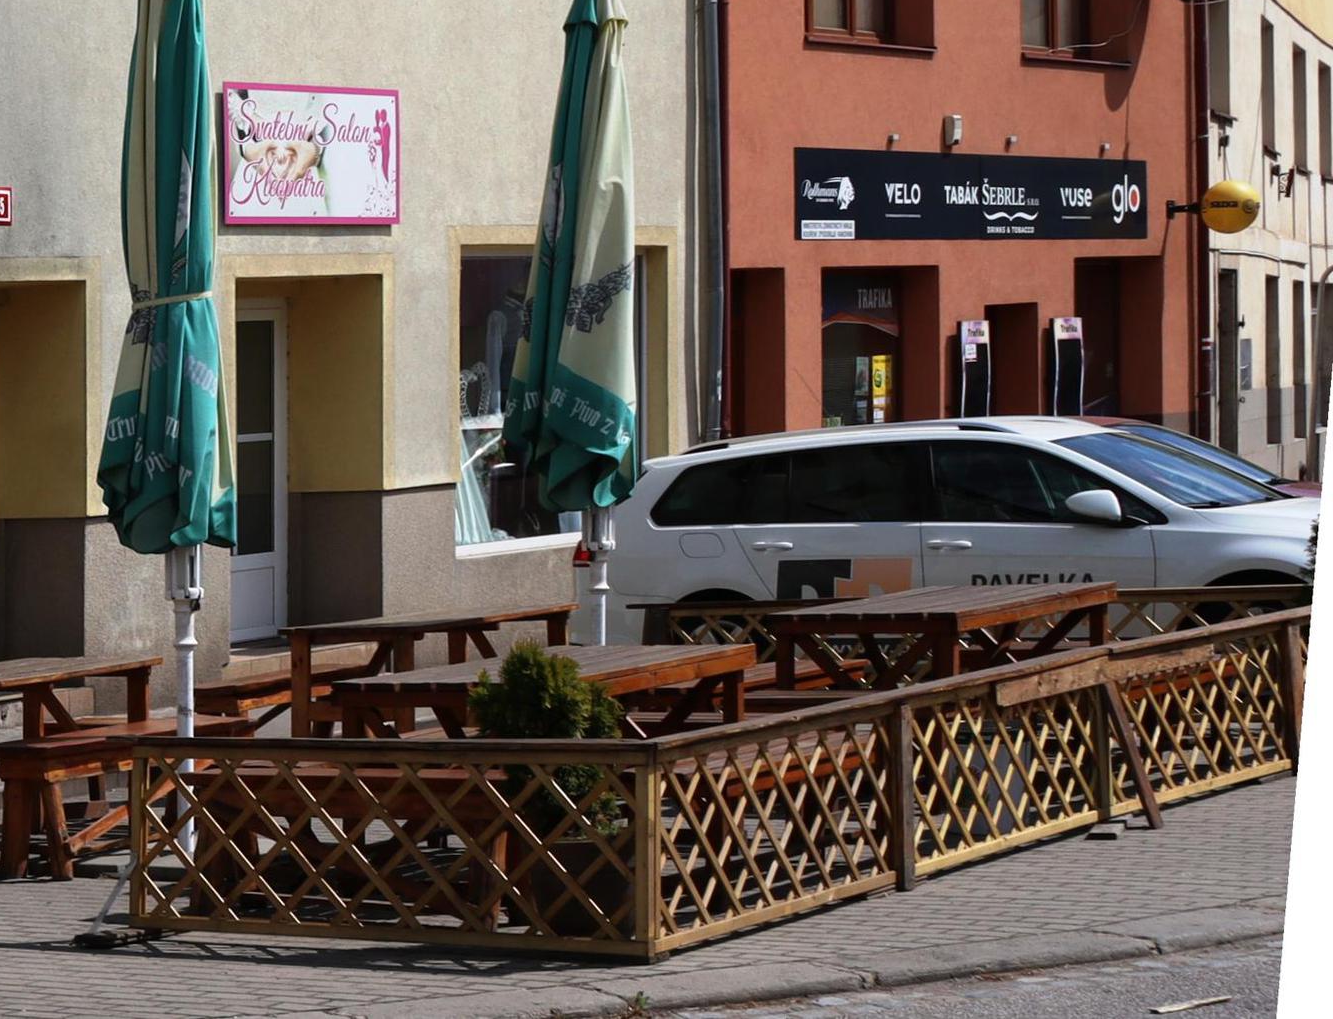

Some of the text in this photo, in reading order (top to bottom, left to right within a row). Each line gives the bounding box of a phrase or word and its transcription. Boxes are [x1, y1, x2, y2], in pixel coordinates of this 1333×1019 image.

[231, 99, 370, 145] Svatební Salon
[232, 157, 326, 209] Kleopatra
[884, 183, 922, 204] VELO
[944, 181, 979, 204] TABÁK
[982, 178, 1026, 205] ŠEBRLE
[1112, 174, 1141, 224] glo
[857, 288, 893, 310] TRAFIKA
